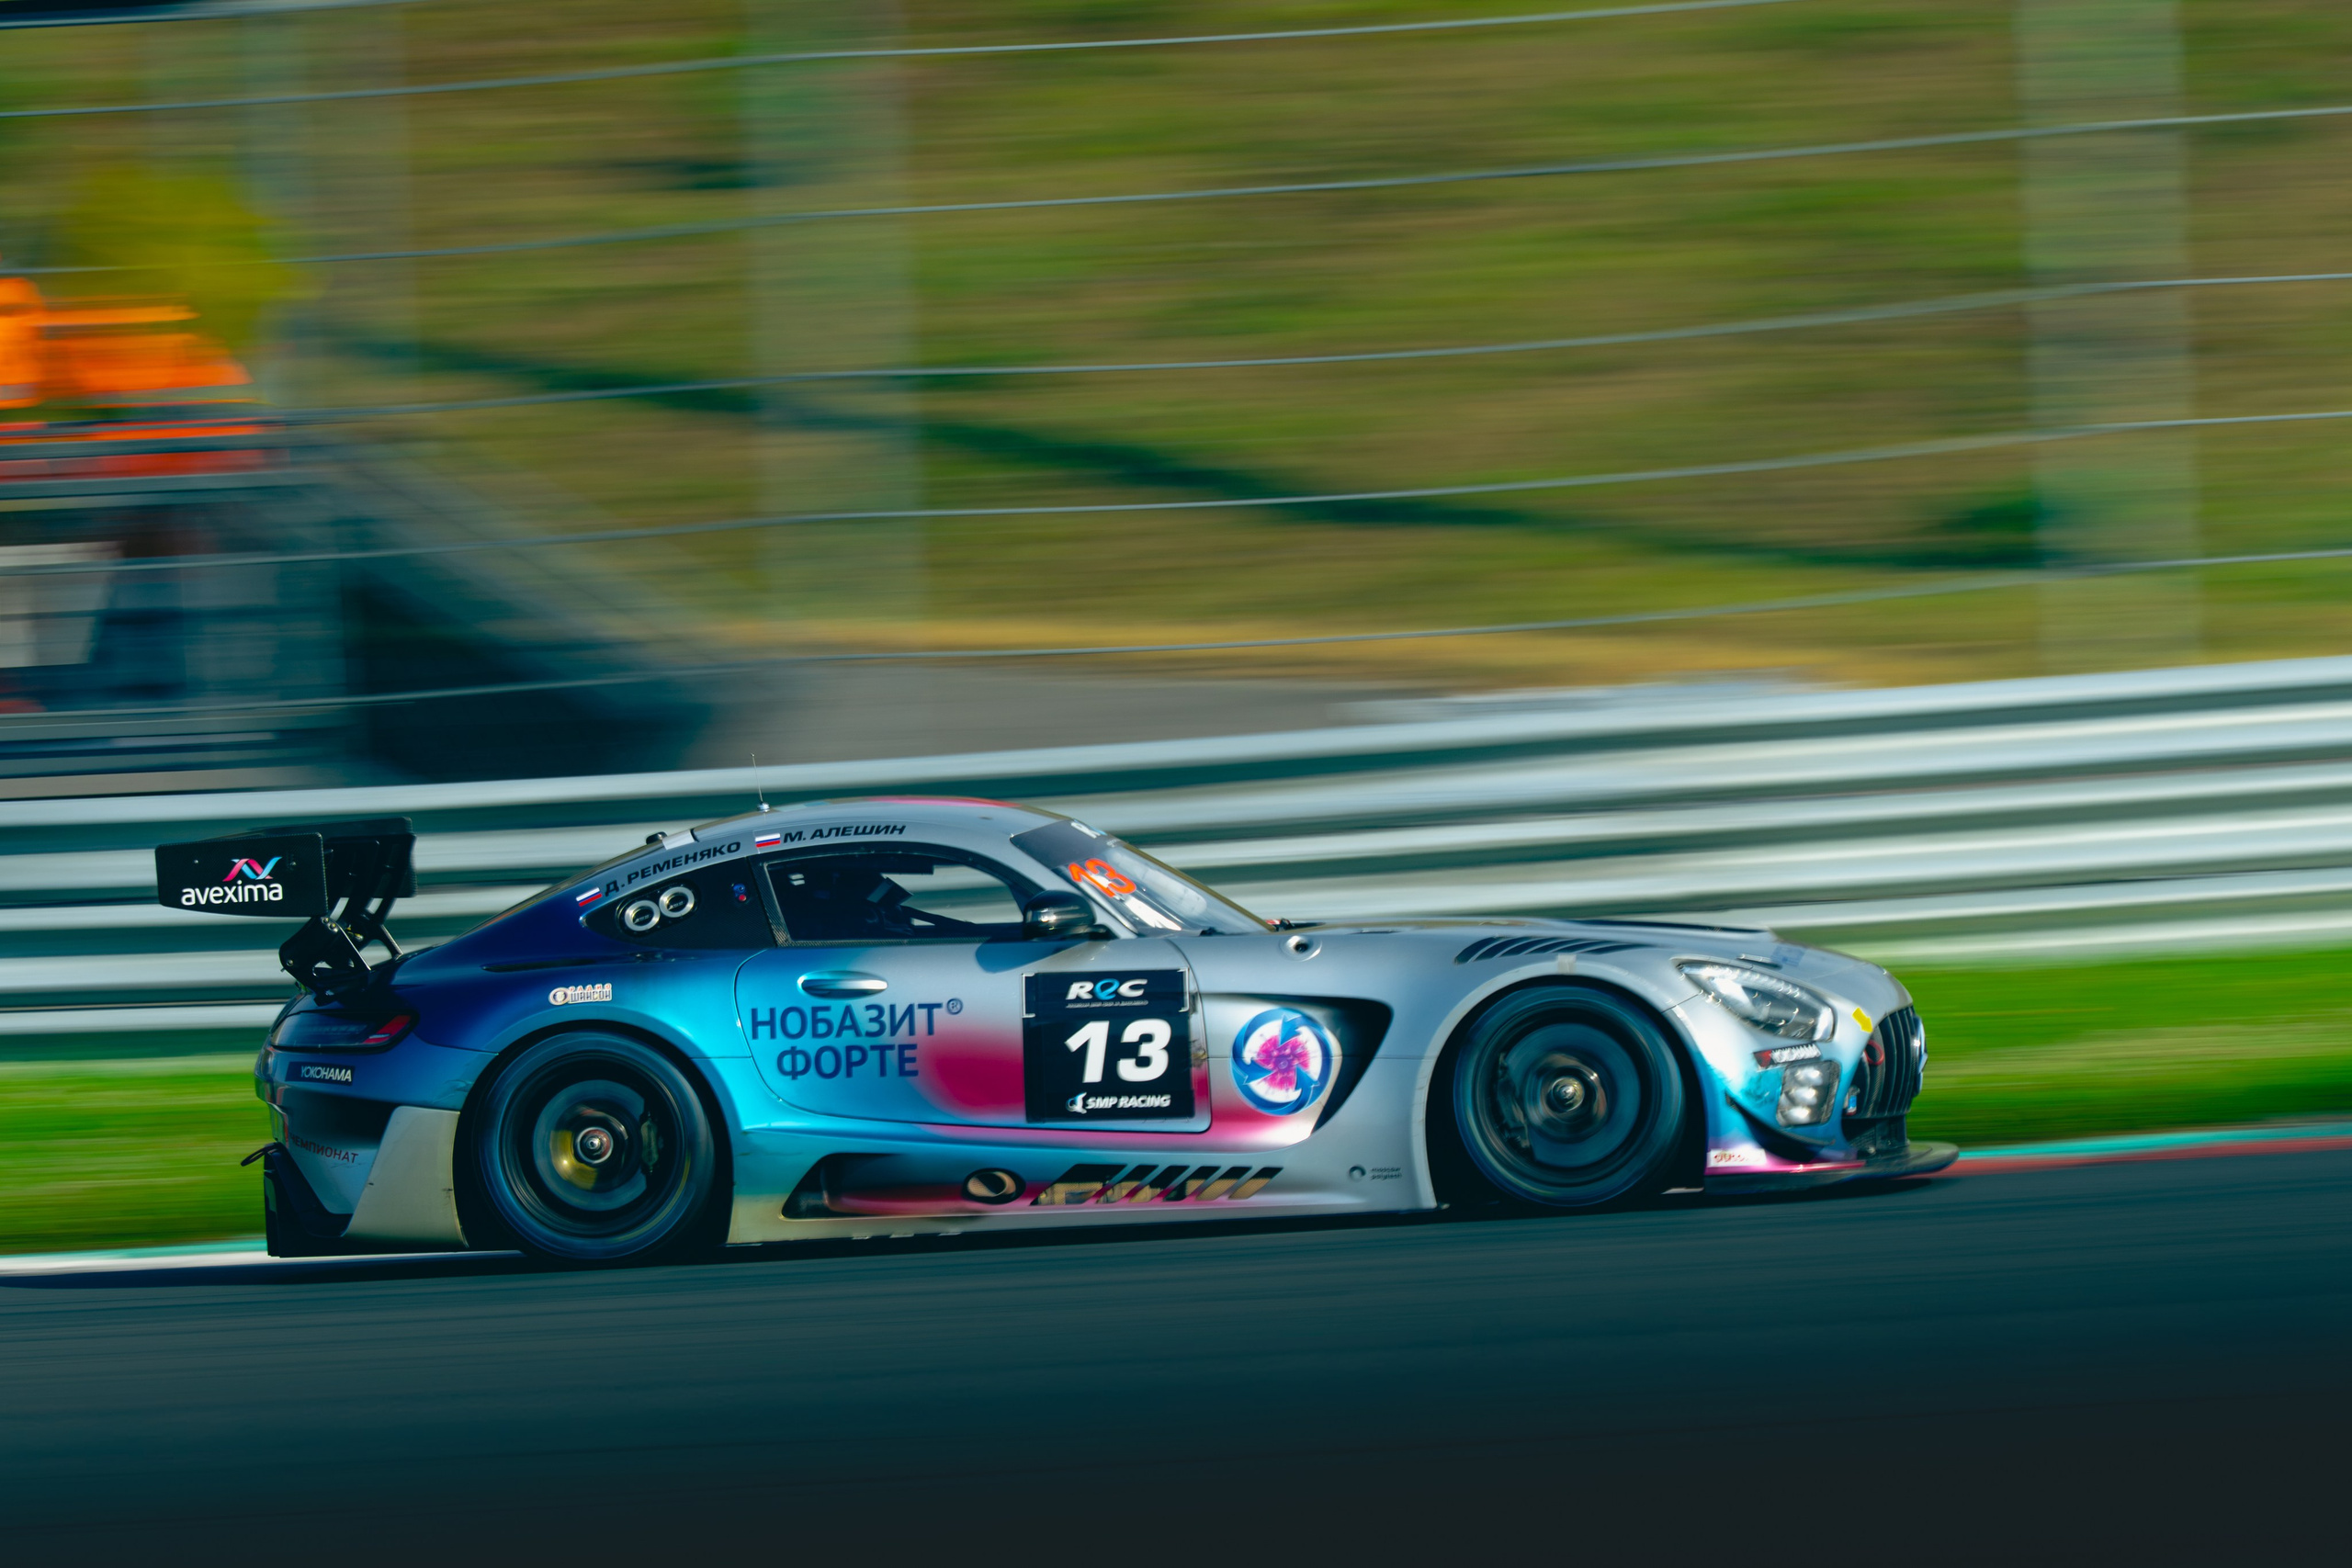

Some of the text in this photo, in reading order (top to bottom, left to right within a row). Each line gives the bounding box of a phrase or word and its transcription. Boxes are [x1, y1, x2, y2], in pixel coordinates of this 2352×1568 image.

[810, 824, 906, 840] АЛЕШИН
[627, 840, 741, 884] РЕМЕНЯКО
[1068, 857, 1136, 898] 13
[181, 879, 283, 907] avexima
[776, 1043, 920, 1081] ФОРТЕ
[1064, 1018, 1172, 1084] 13
[300, 1065, 353, 1083] YOKOHAMA
[1085, 1094, 1171, 1110] SMP RACING
[289, 1132, 359, 1164] ЧЕМПИОНАТ
